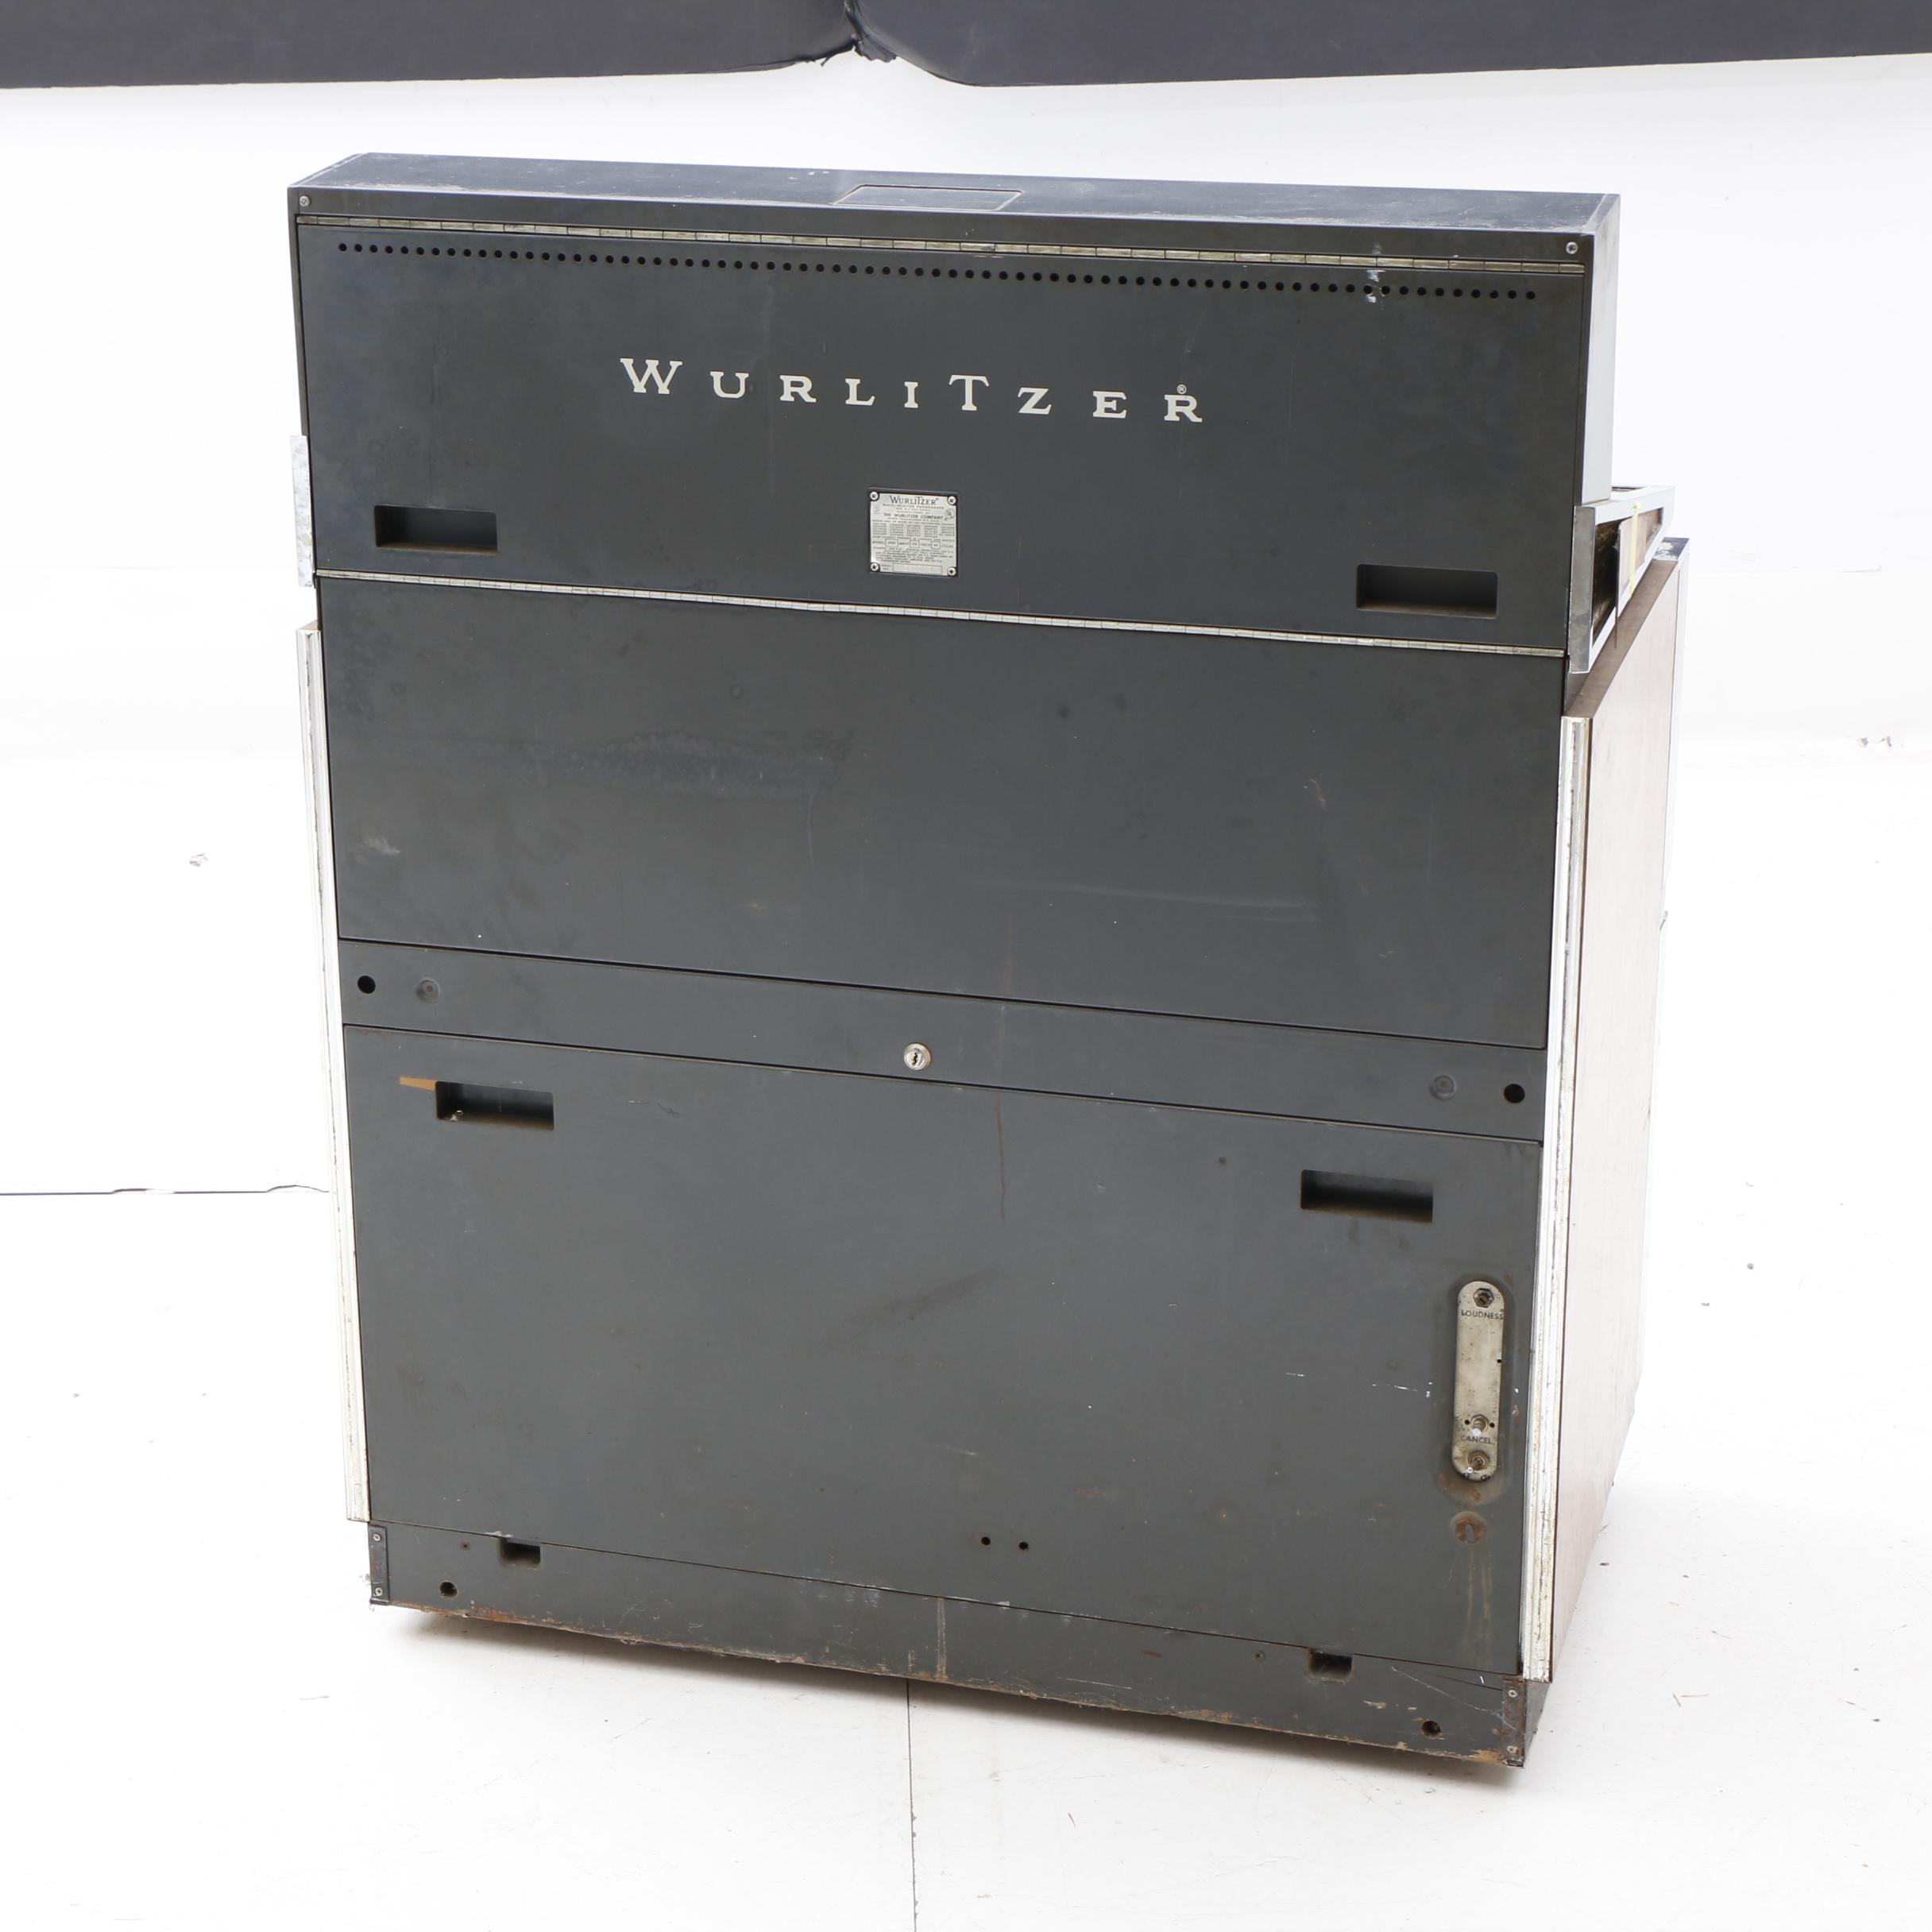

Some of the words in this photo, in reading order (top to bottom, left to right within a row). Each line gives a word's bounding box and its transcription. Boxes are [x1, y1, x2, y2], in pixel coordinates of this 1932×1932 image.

[620, 357, 1203, 423] WURLITZER
[1462, 1310, 1504, 1320] LOUDNESS
[1461, 1435, 1492, 1444] CANCEL
